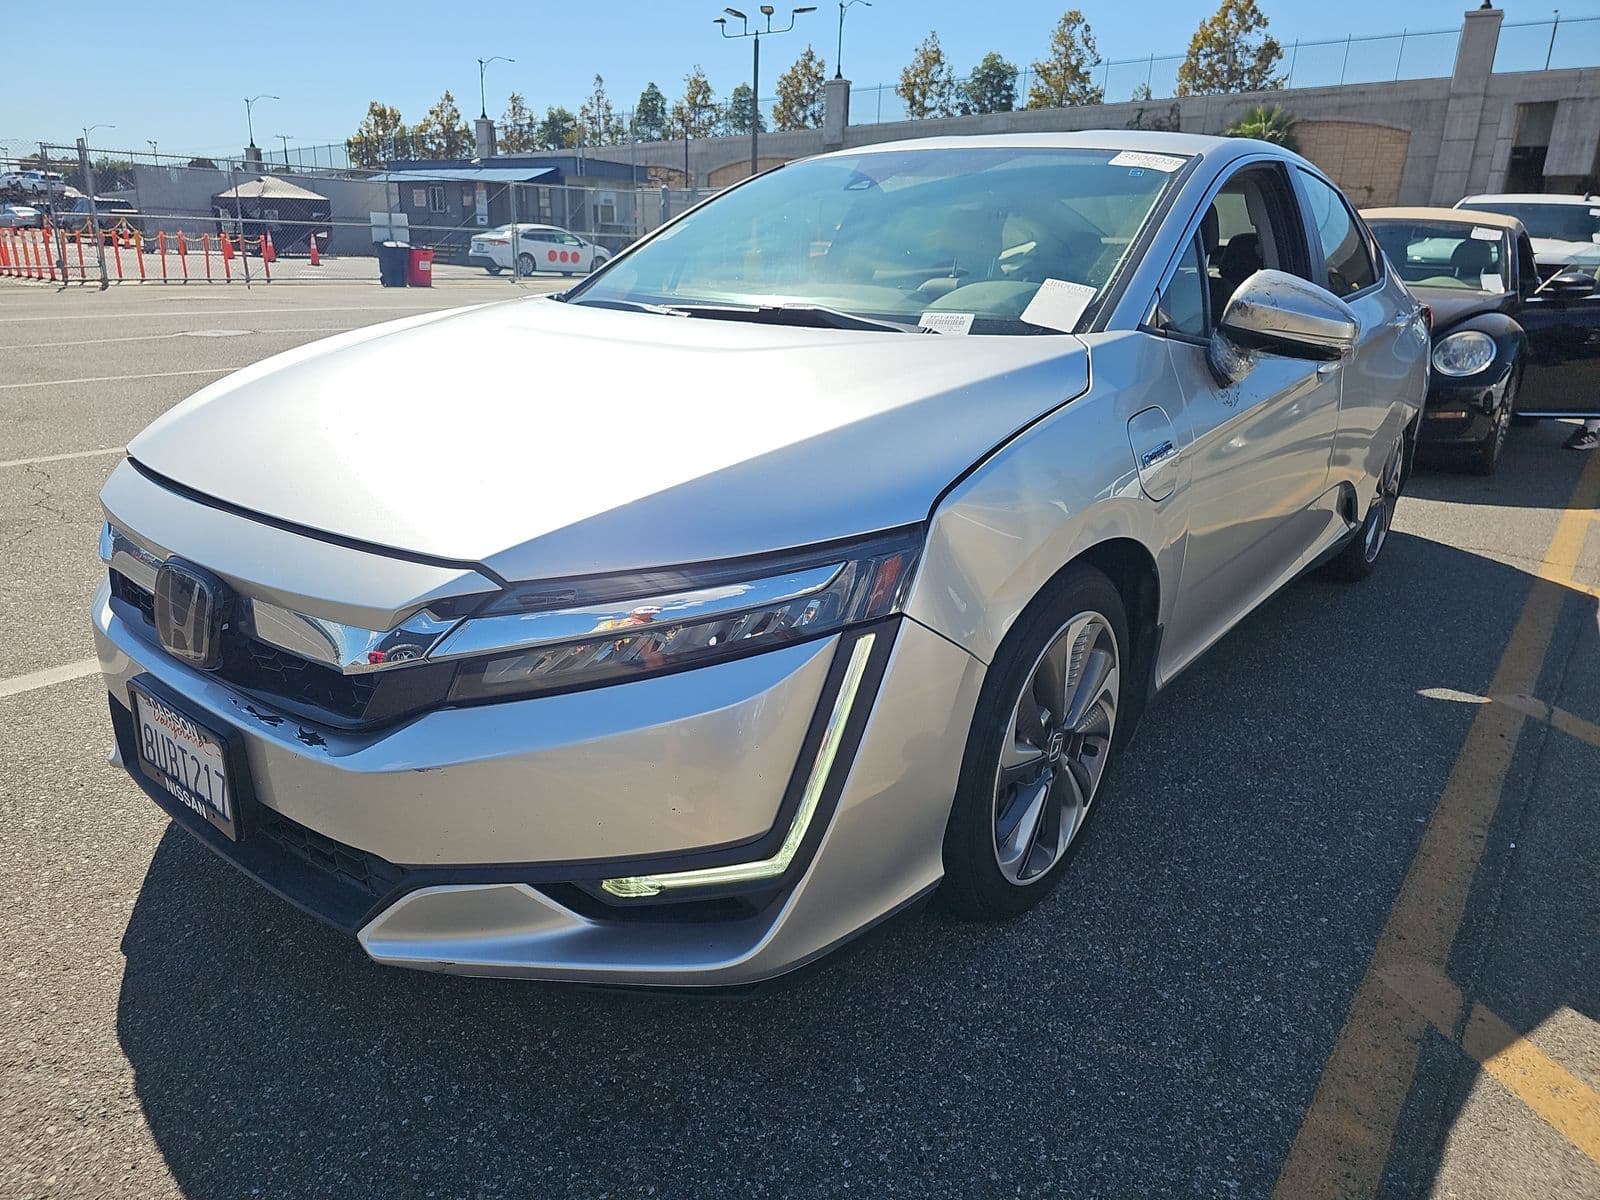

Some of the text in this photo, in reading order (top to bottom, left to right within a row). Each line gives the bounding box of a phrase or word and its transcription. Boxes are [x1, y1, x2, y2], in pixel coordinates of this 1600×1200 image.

[149, 697, 199, 741] CARSON
[143, 723, 226, 819] 8UBT217
[164, 776, 207, 819] NISSAN
